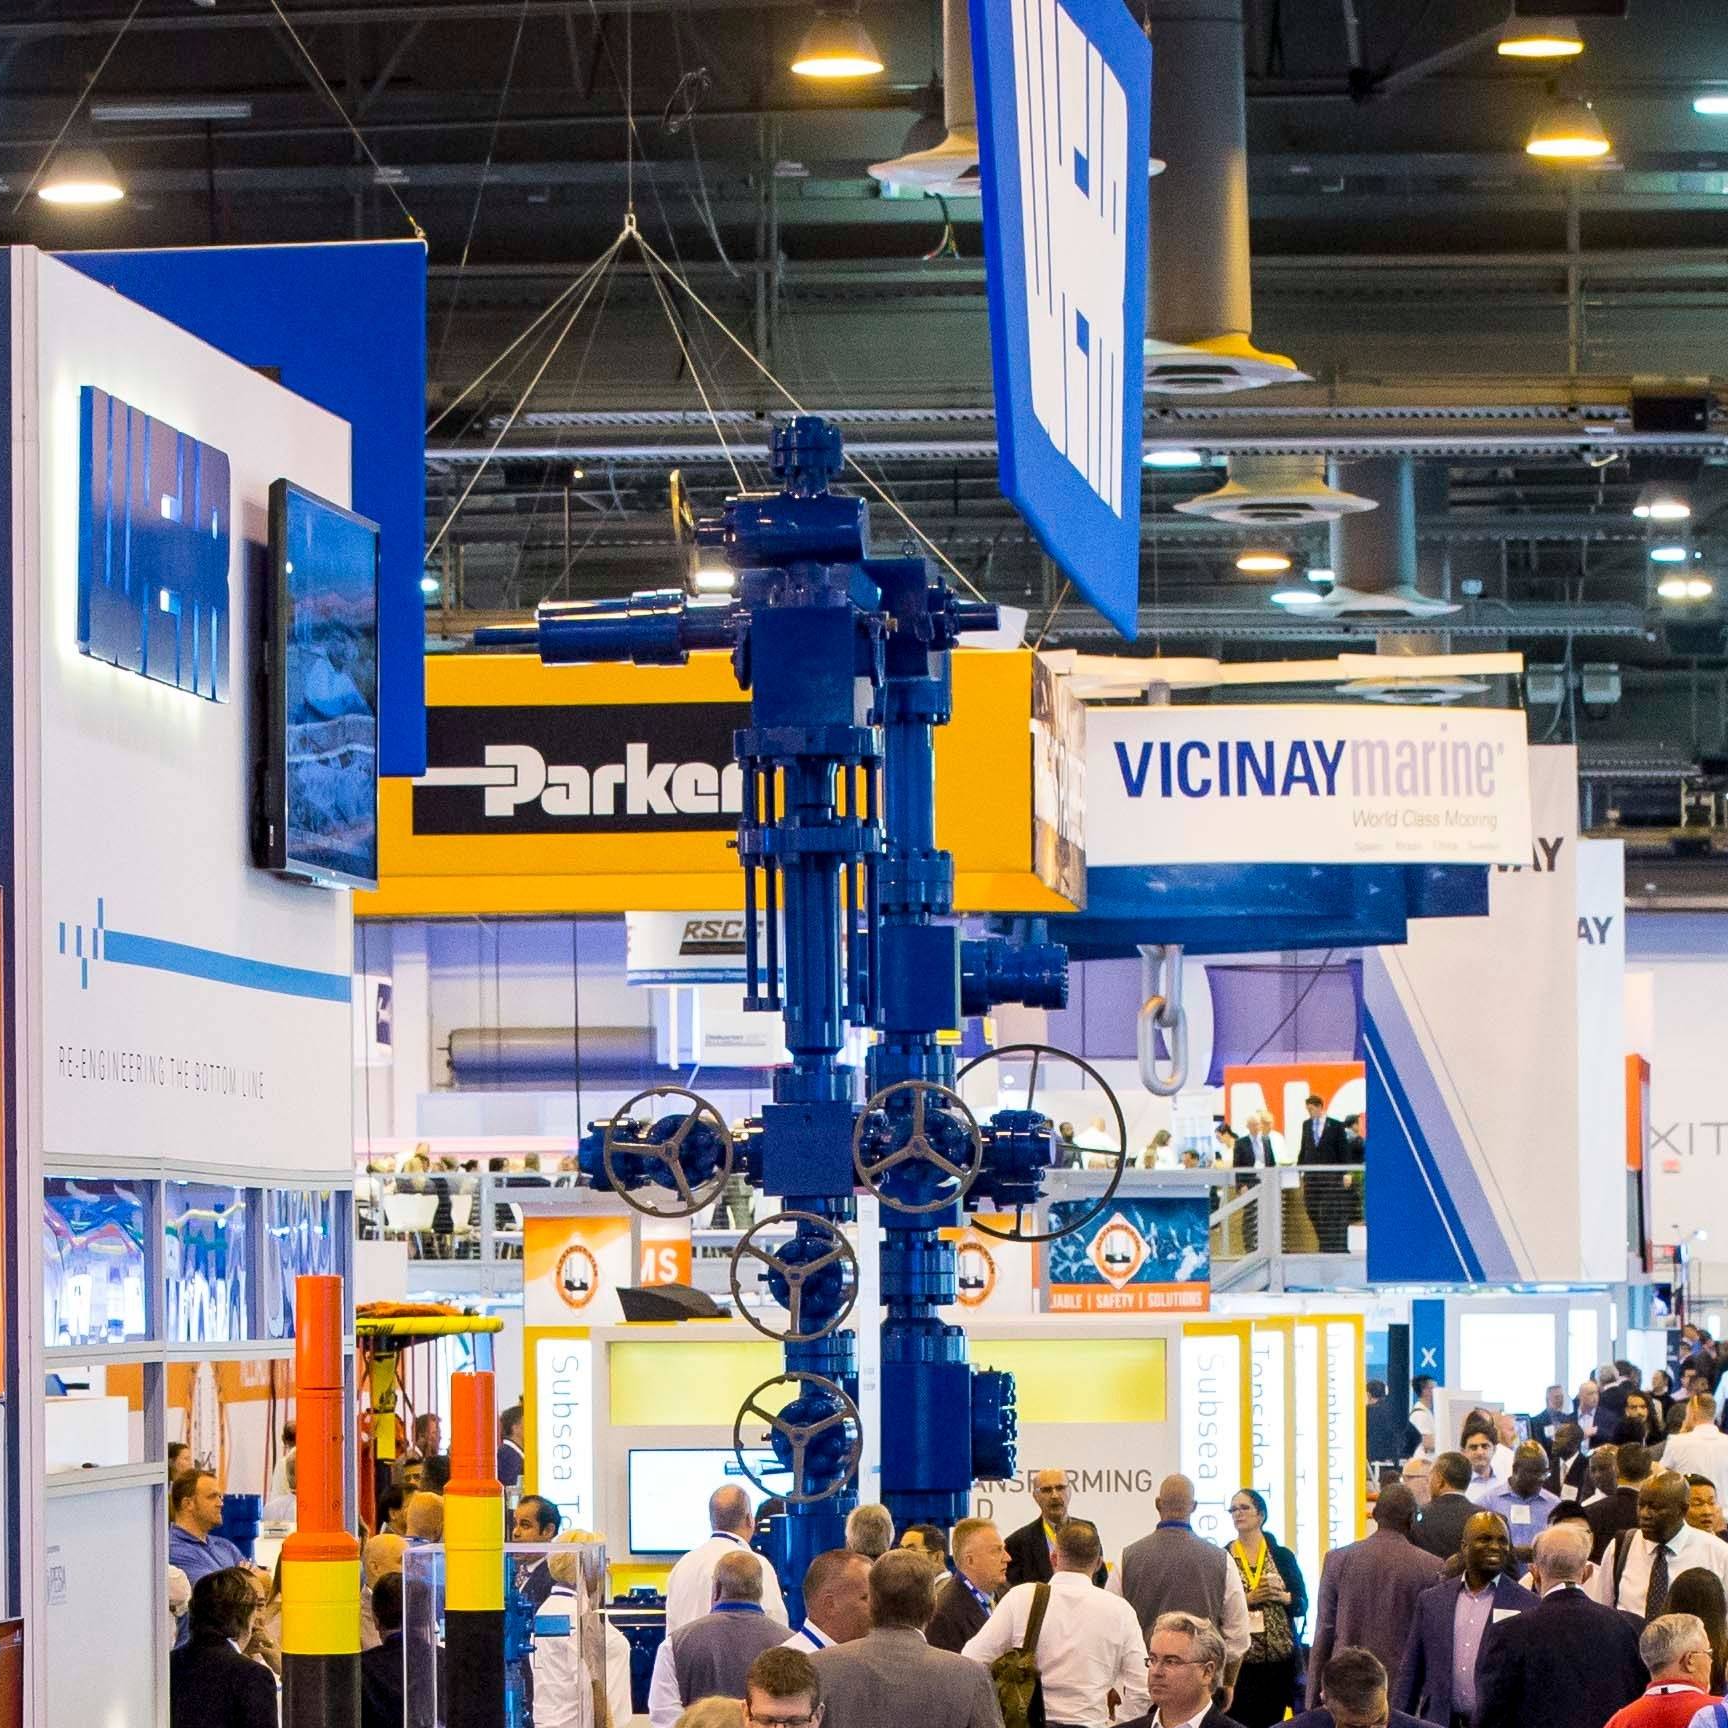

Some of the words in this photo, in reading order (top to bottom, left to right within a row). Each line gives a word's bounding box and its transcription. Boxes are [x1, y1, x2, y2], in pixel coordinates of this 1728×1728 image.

[58, 1045, 165, 1087] RE-ENGINEERING
[168, 1056, 190, 1090] THE
[551, 1355, 580, 1481] Subsea
[1198, 1352, 1225, 1480] Subsea
